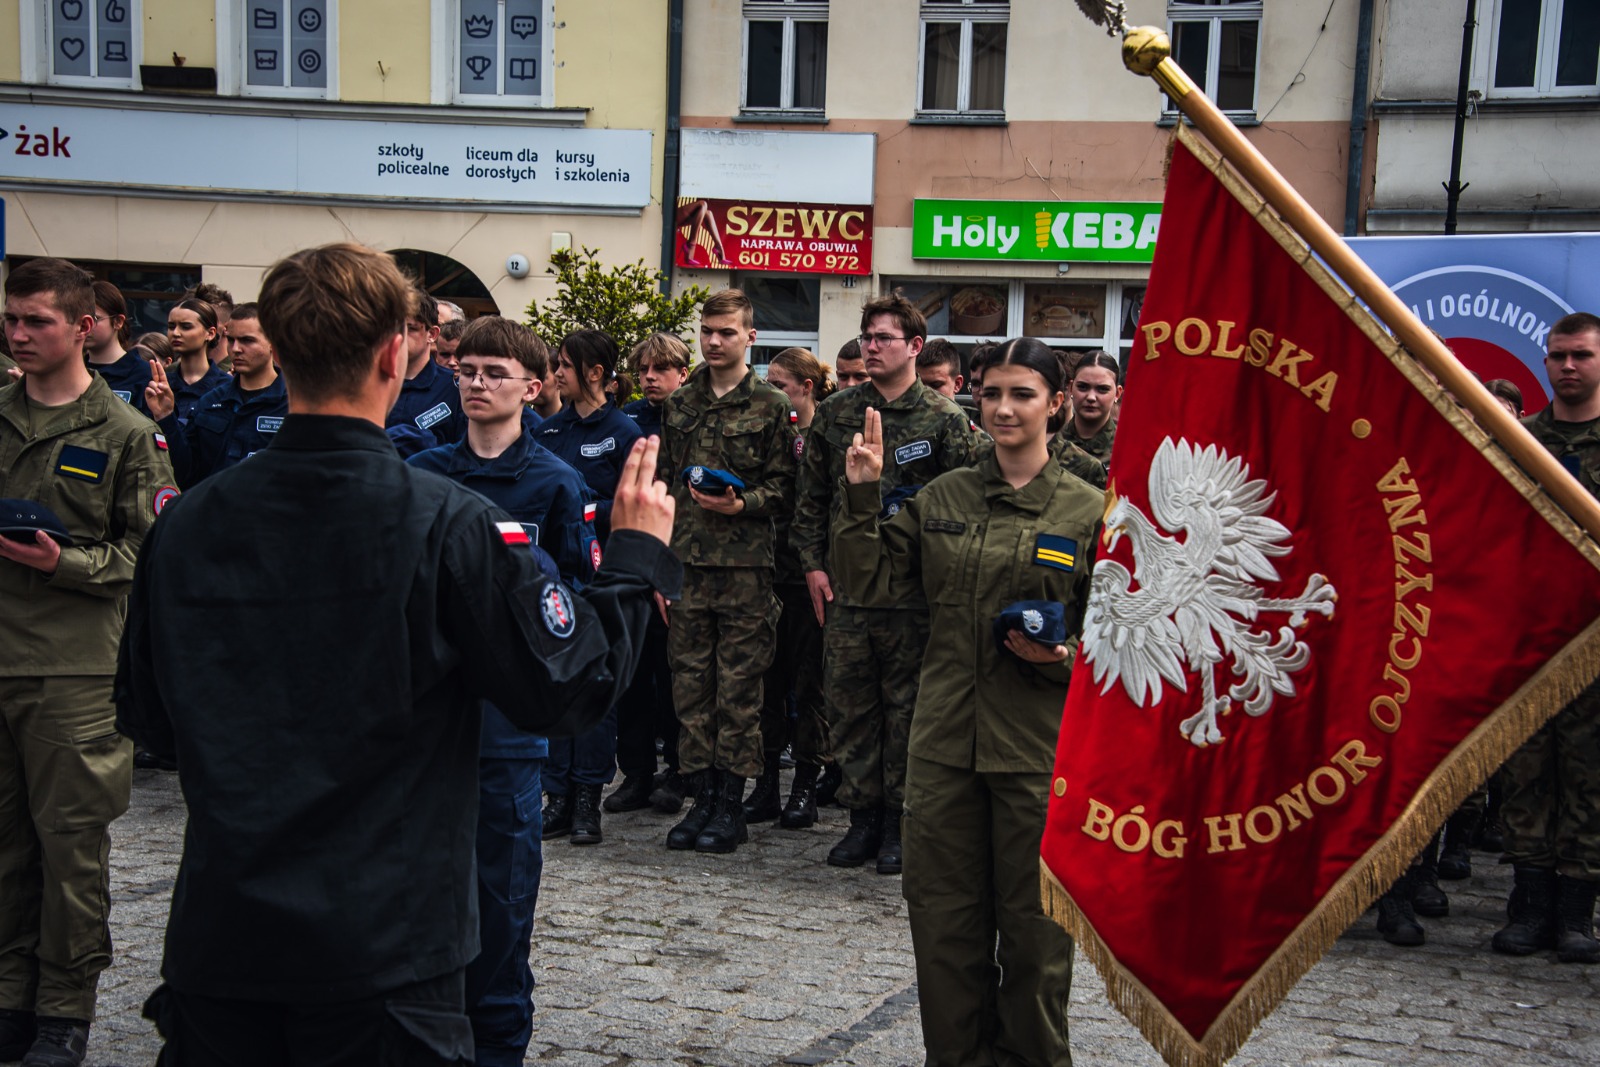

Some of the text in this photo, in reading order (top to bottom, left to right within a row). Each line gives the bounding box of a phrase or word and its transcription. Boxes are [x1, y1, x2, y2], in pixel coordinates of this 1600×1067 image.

[15, 125, 71, 158] żak
[378, 143, 424, 160] szkoły
[466, 146, 539, 163] liceum dla
[556, 150, 595, 167] kursy
[378, 161, 450, 176] policealne
[466, 164, 536, 182] dorosłych
[555, 167, 630, 183] i szkolenia
[725, 206, 865, 240] SZEWC
[932, 214, 1020, 254] Holy
[740, 239, 858, 253] NAPRAWA OBUWIA
[510, 261, 519, 271] 12
[738, 251, 859, 270] 601 570 972
[1440, 289, 1551, 354] OGÓLNOK
[1141, 318, 1338, 412] POLSKA
[1081, 456, 1434, 859] BÓG HONOR OJCZYZNA
